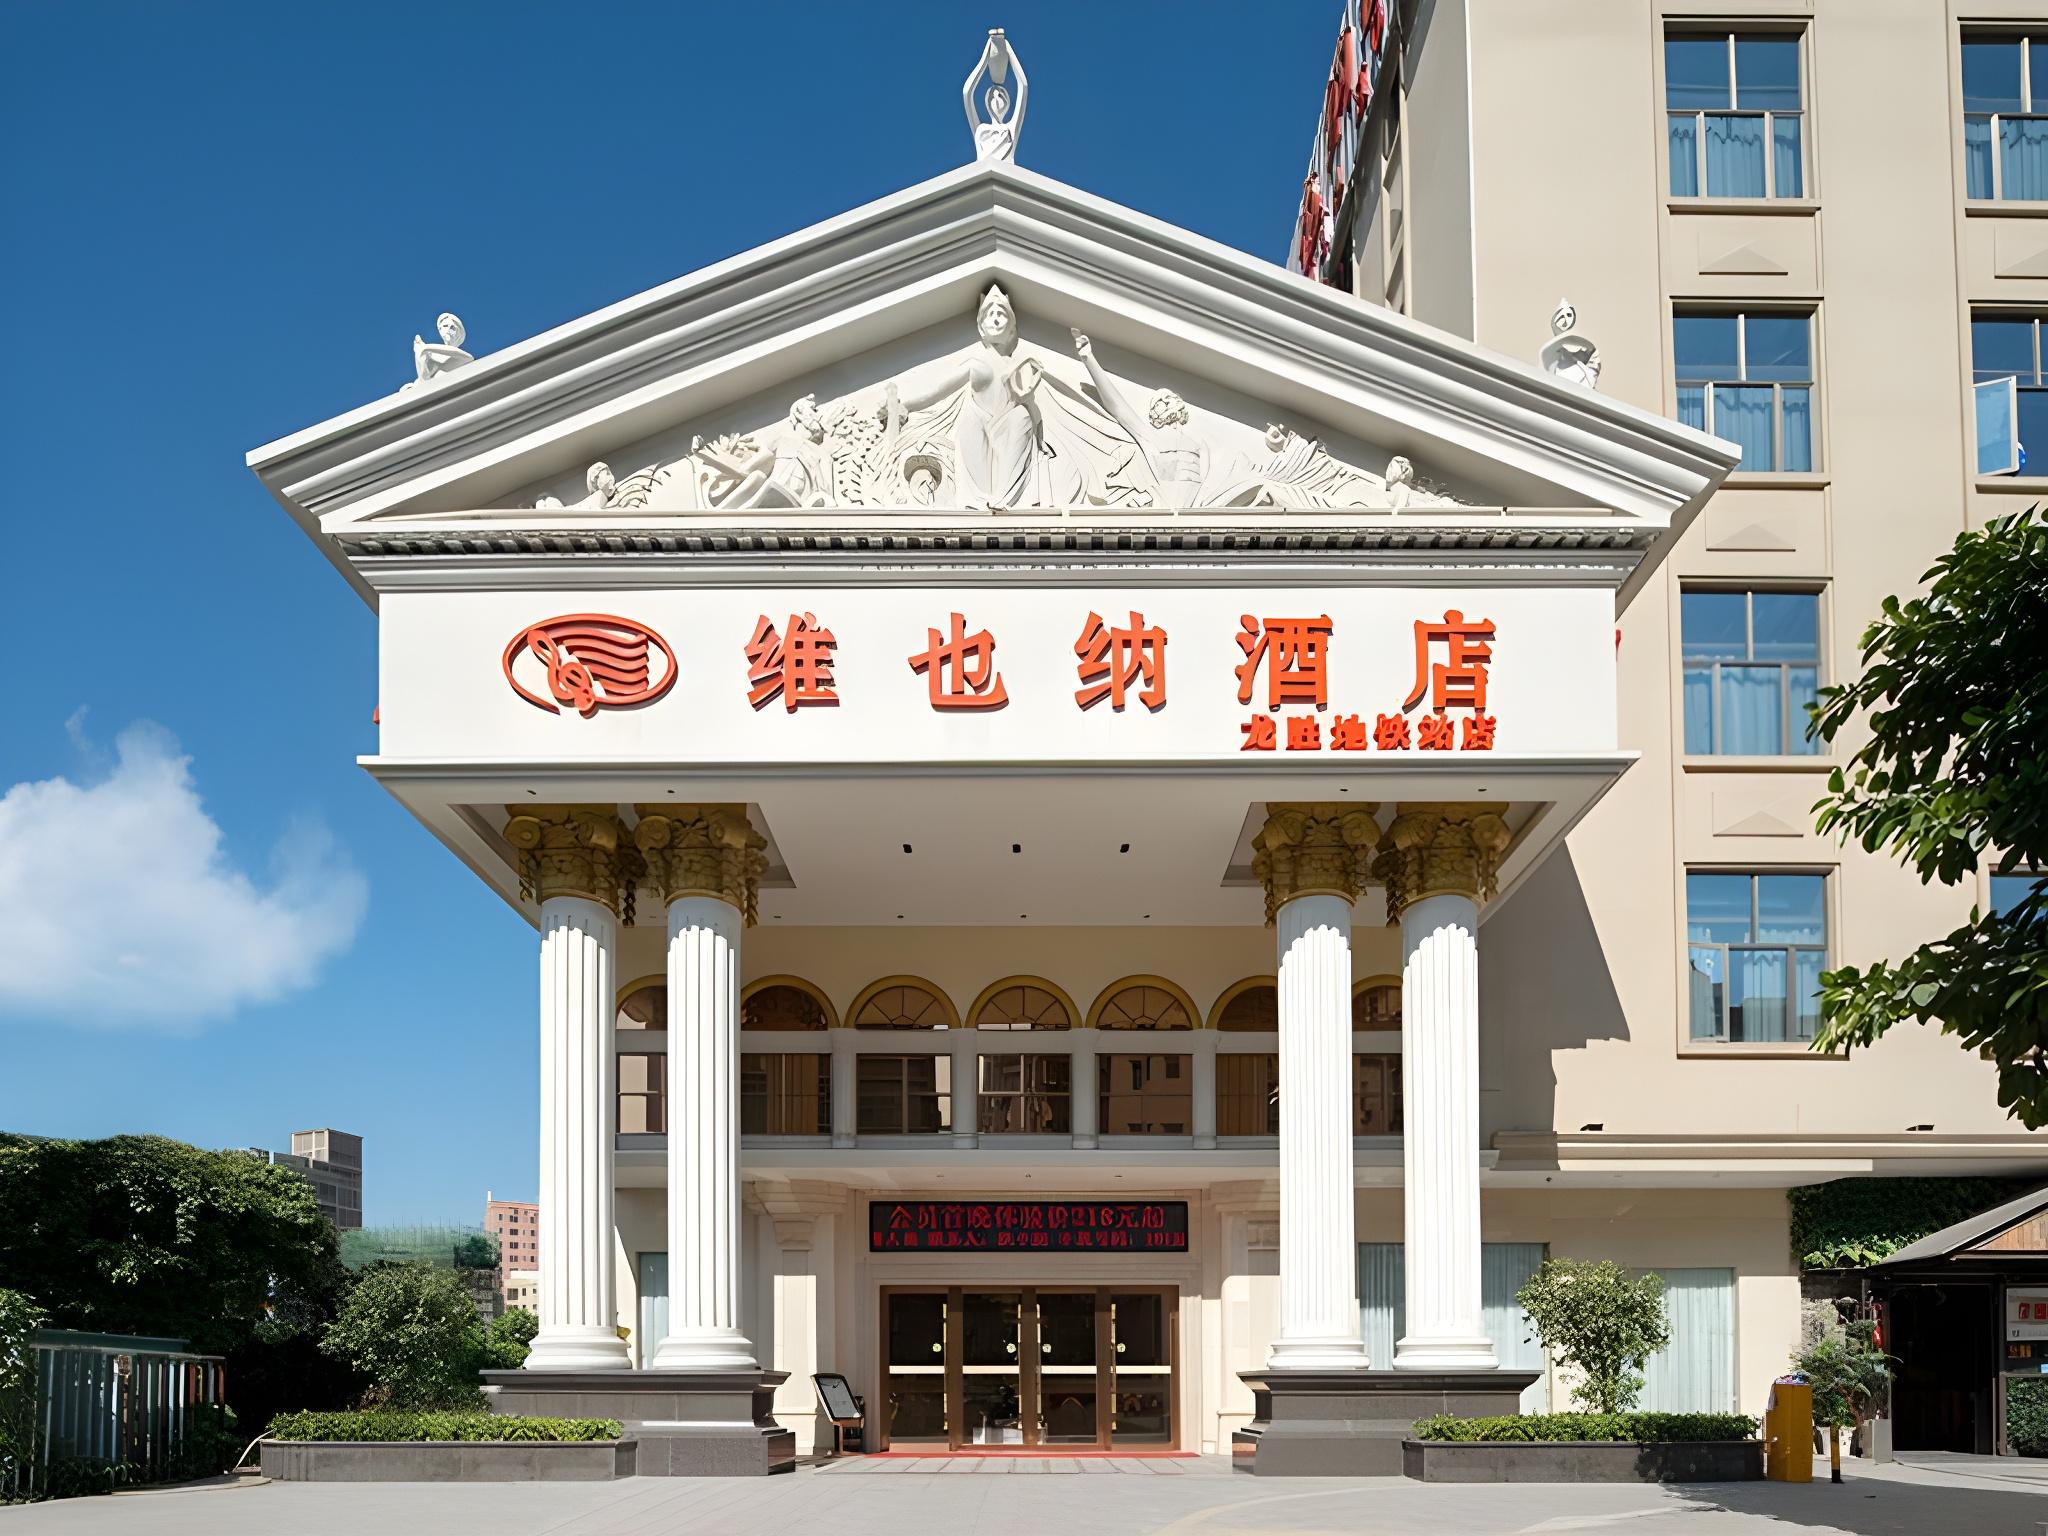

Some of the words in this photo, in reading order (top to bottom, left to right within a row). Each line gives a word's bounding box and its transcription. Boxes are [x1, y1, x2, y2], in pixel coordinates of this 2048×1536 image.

[744, 609, 1497, 713] 维也纳酒店
